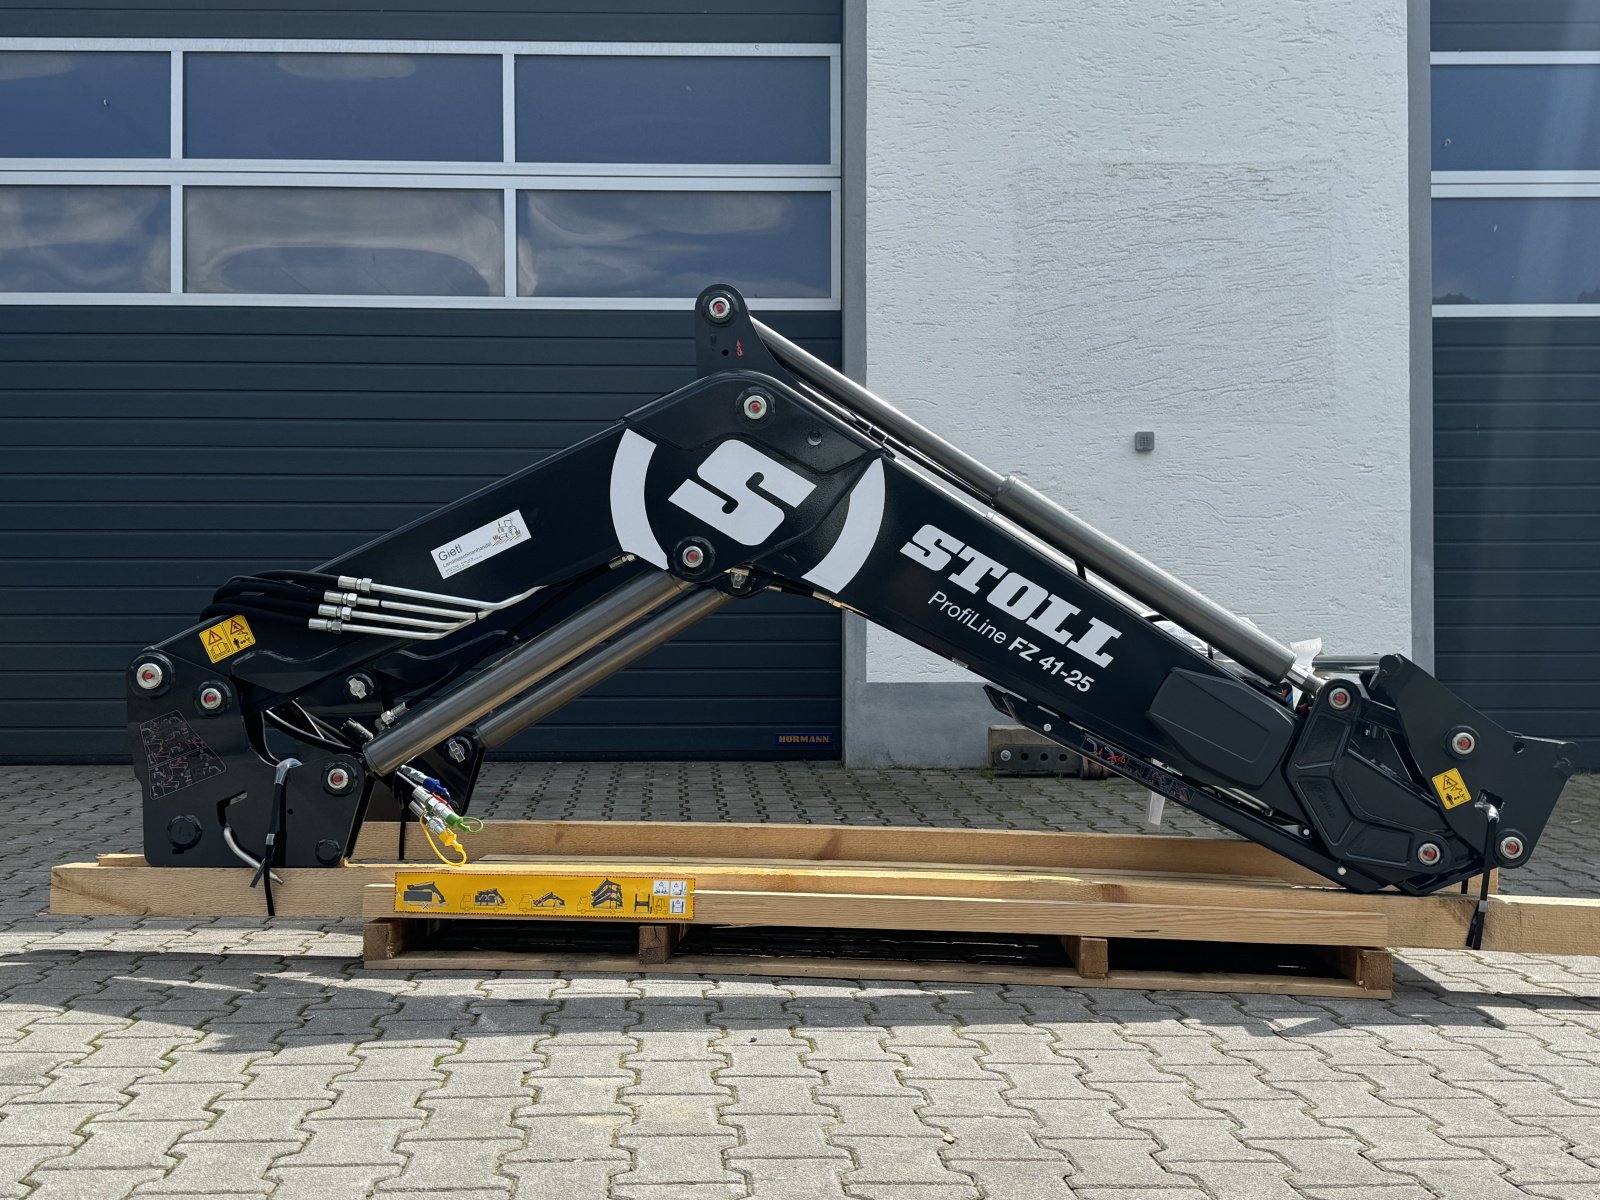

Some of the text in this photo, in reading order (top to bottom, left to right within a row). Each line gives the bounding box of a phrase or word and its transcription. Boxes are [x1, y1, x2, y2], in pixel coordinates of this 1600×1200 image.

[667, 438, 818, 546] S
[438, 543, 463, 561] Gietl
[899, 523, 1123, 669] STOLL
[927, 590, 1095, 693] ProfiLine FZ 41-25
